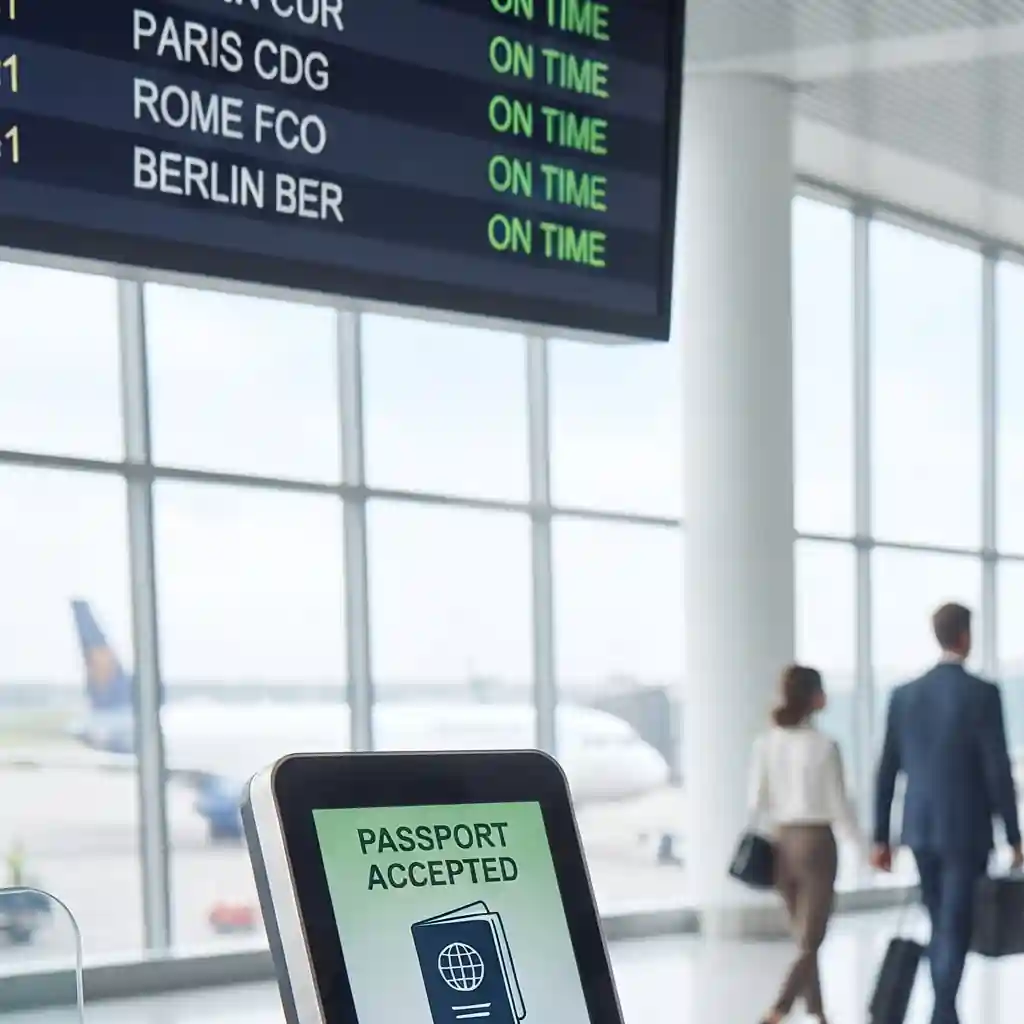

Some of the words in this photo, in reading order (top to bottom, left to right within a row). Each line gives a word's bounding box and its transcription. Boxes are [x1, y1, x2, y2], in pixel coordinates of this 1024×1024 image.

[133, 8, 244, 73] PARIS
[254, 38, 329, 91] CDG
[489, 35, 534, 80] ON
[541, 48, 610, 98] TIME
[133, 77, 244, 140] ROME
[255, 103, 327, 154] FCO
[488, 94, 533, 138] ON
[540, 105, 608, 156] TIME
[133, 145, 264, 209] BERLIN
[275, 173, 344, 222] BER
[488, 154, 533, 198] ON
[540, 163, 608, 212] TIME
[487, 213, 532, 255] ON
[539, 221, 607, 268] TIME
[357, 822, 508, 855] PASSPORT
[368, 856, 518, 891] ACCEPTED
